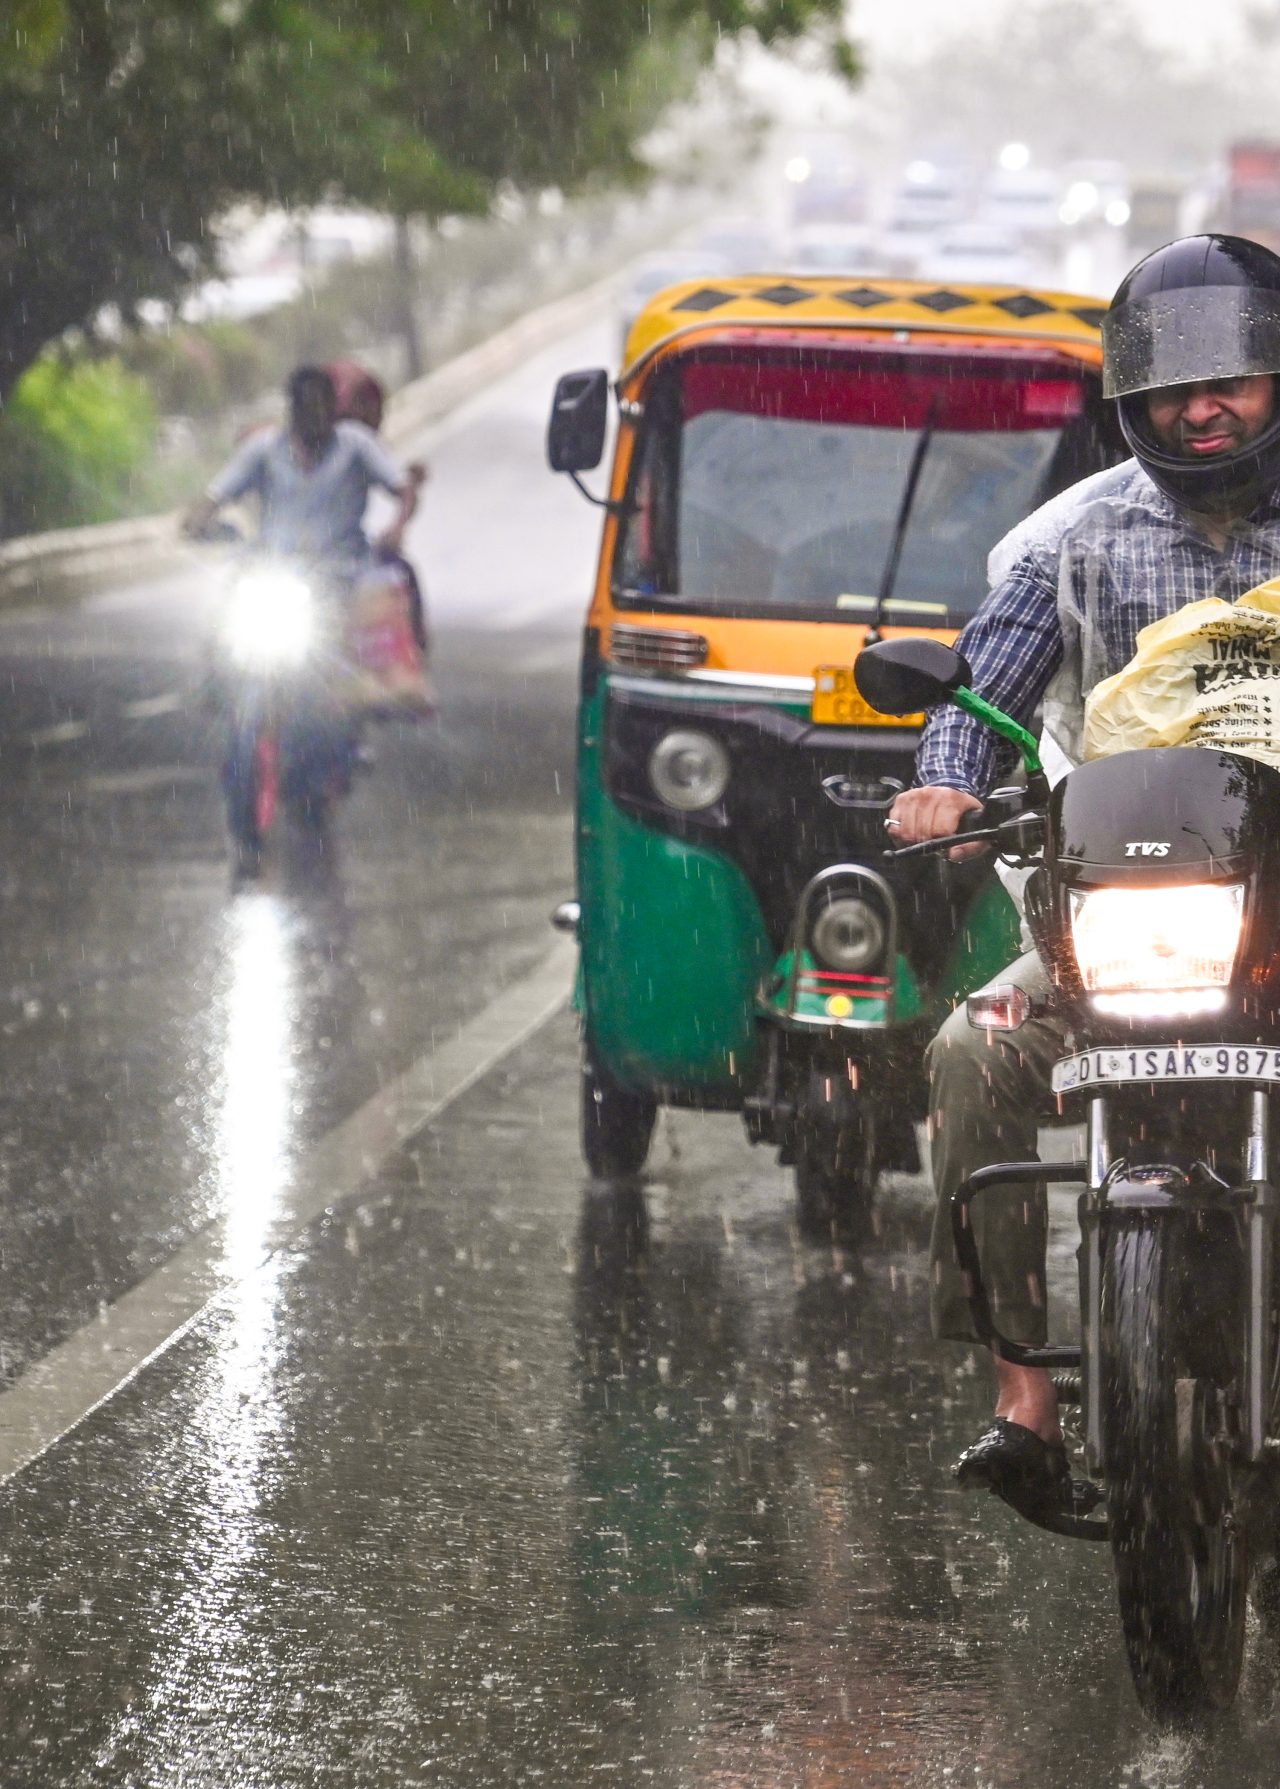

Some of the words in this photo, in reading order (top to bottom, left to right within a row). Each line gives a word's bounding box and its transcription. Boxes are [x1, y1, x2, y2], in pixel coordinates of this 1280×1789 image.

[1125, 842, 1171, 857] TVS
[1080, 1053, 1109, 1081] DL
[1129, 1050, 1197, 1076] 1SAK
